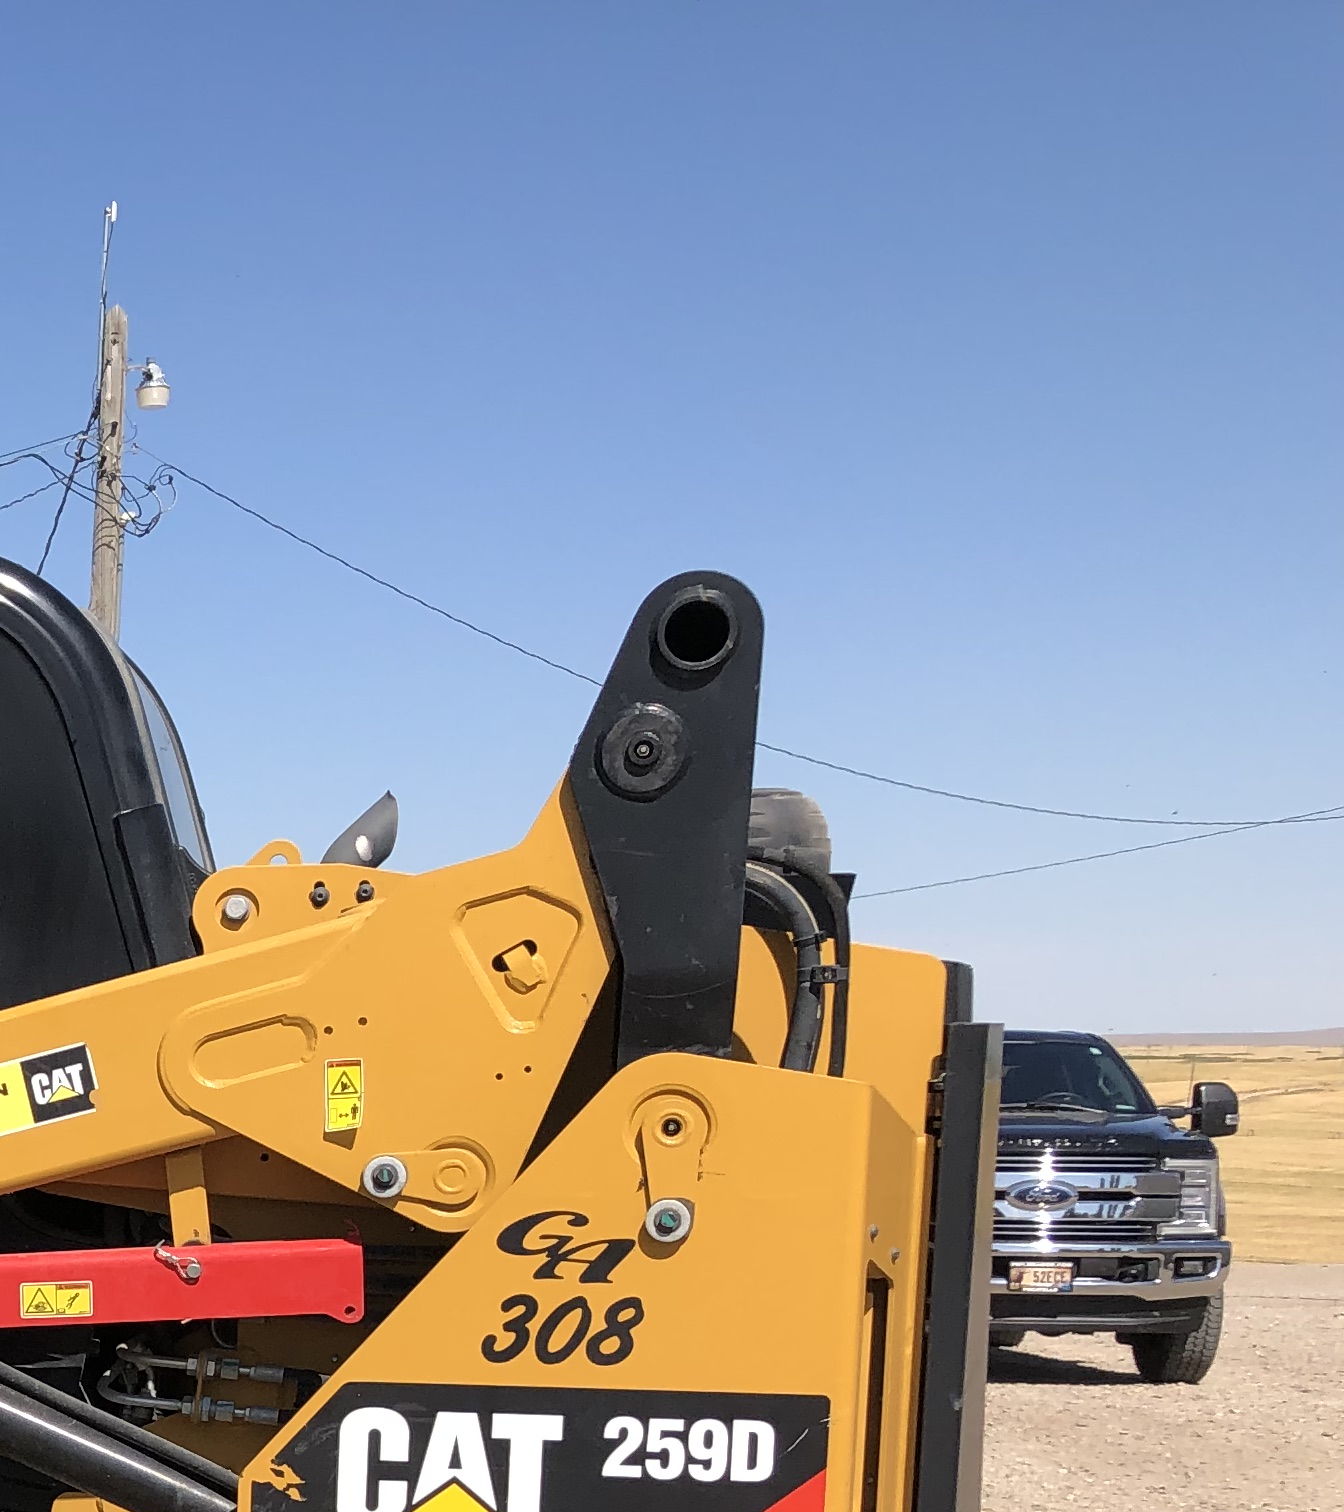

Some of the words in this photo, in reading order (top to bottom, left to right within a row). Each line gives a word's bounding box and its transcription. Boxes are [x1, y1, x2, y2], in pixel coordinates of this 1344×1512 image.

[31, 1063, 84, 1105] CAT
[1025, 1186, 1061, 1202] Ford
[480, 1294, 644, 1366] 308
[601, 1416, 776, 1483] 259D
